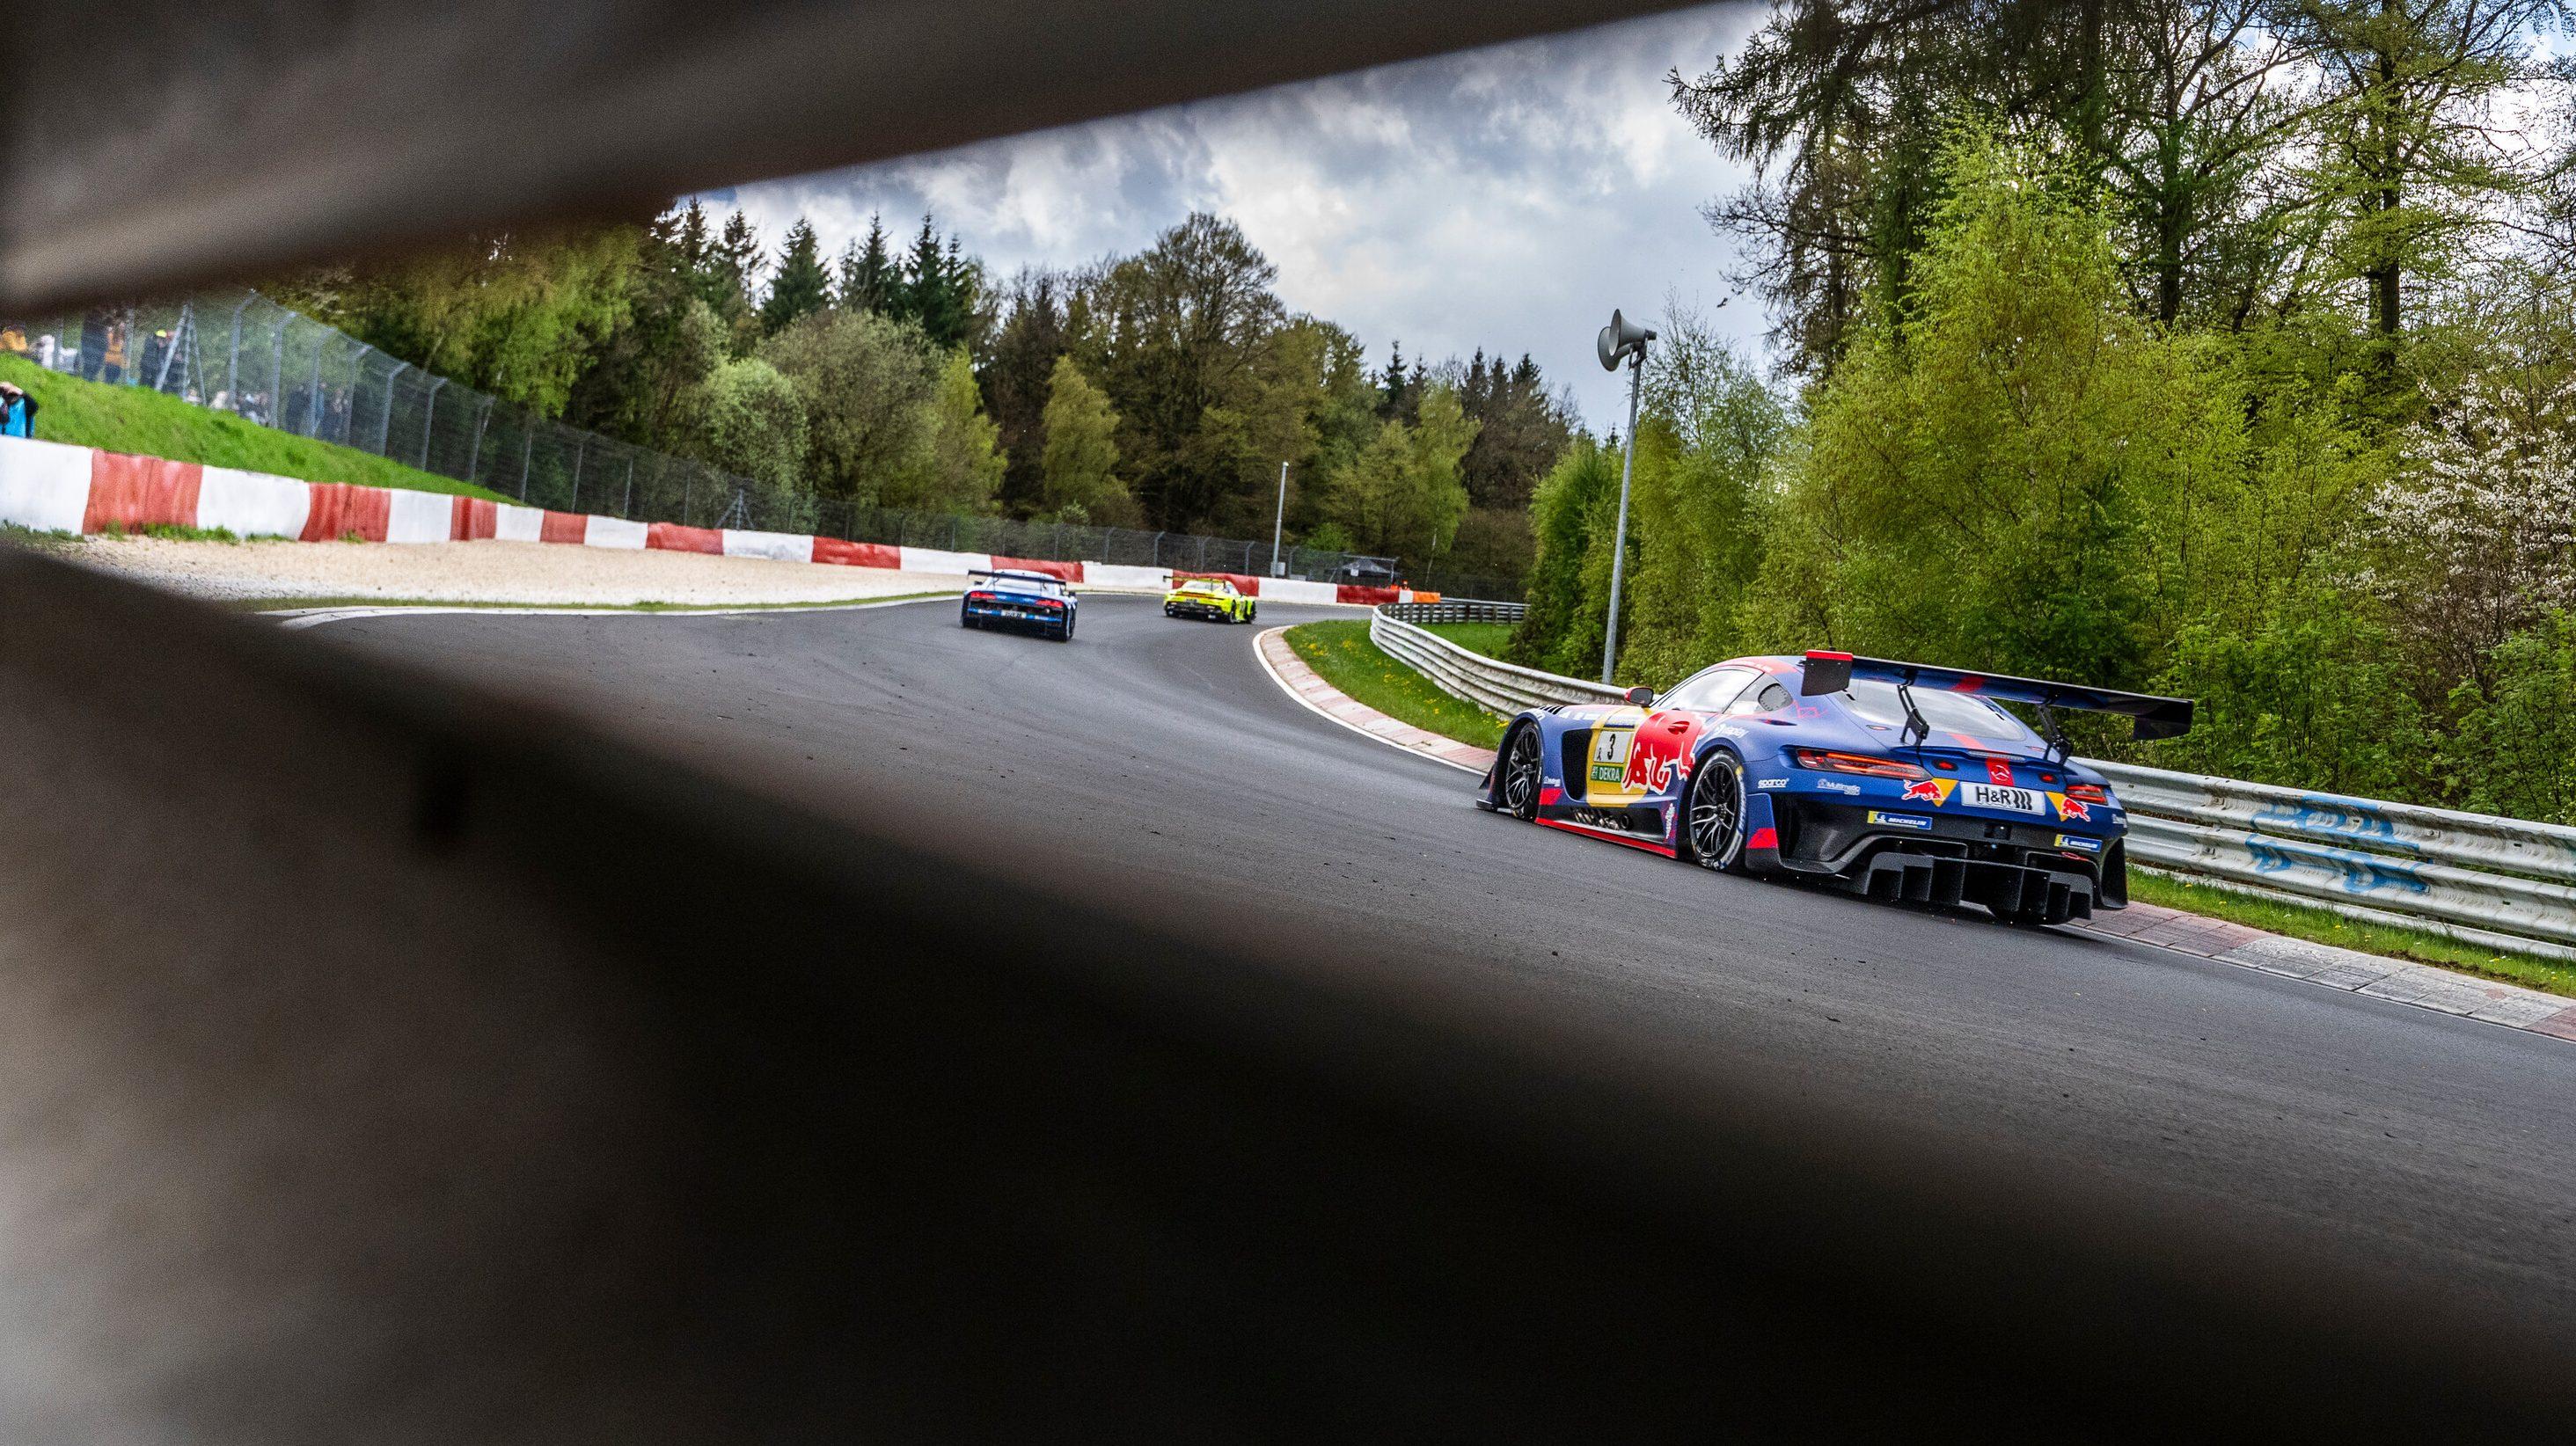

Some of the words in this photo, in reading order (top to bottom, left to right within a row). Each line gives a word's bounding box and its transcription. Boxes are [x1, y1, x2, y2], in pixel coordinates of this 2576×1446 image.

[1607, 734, 1616, 761] 3
[1599, 767, 1621, 781] DEKRA
[1976, 785, 2011, 805] H&R
[1887, 817, 1927, 826] MICHELIN
